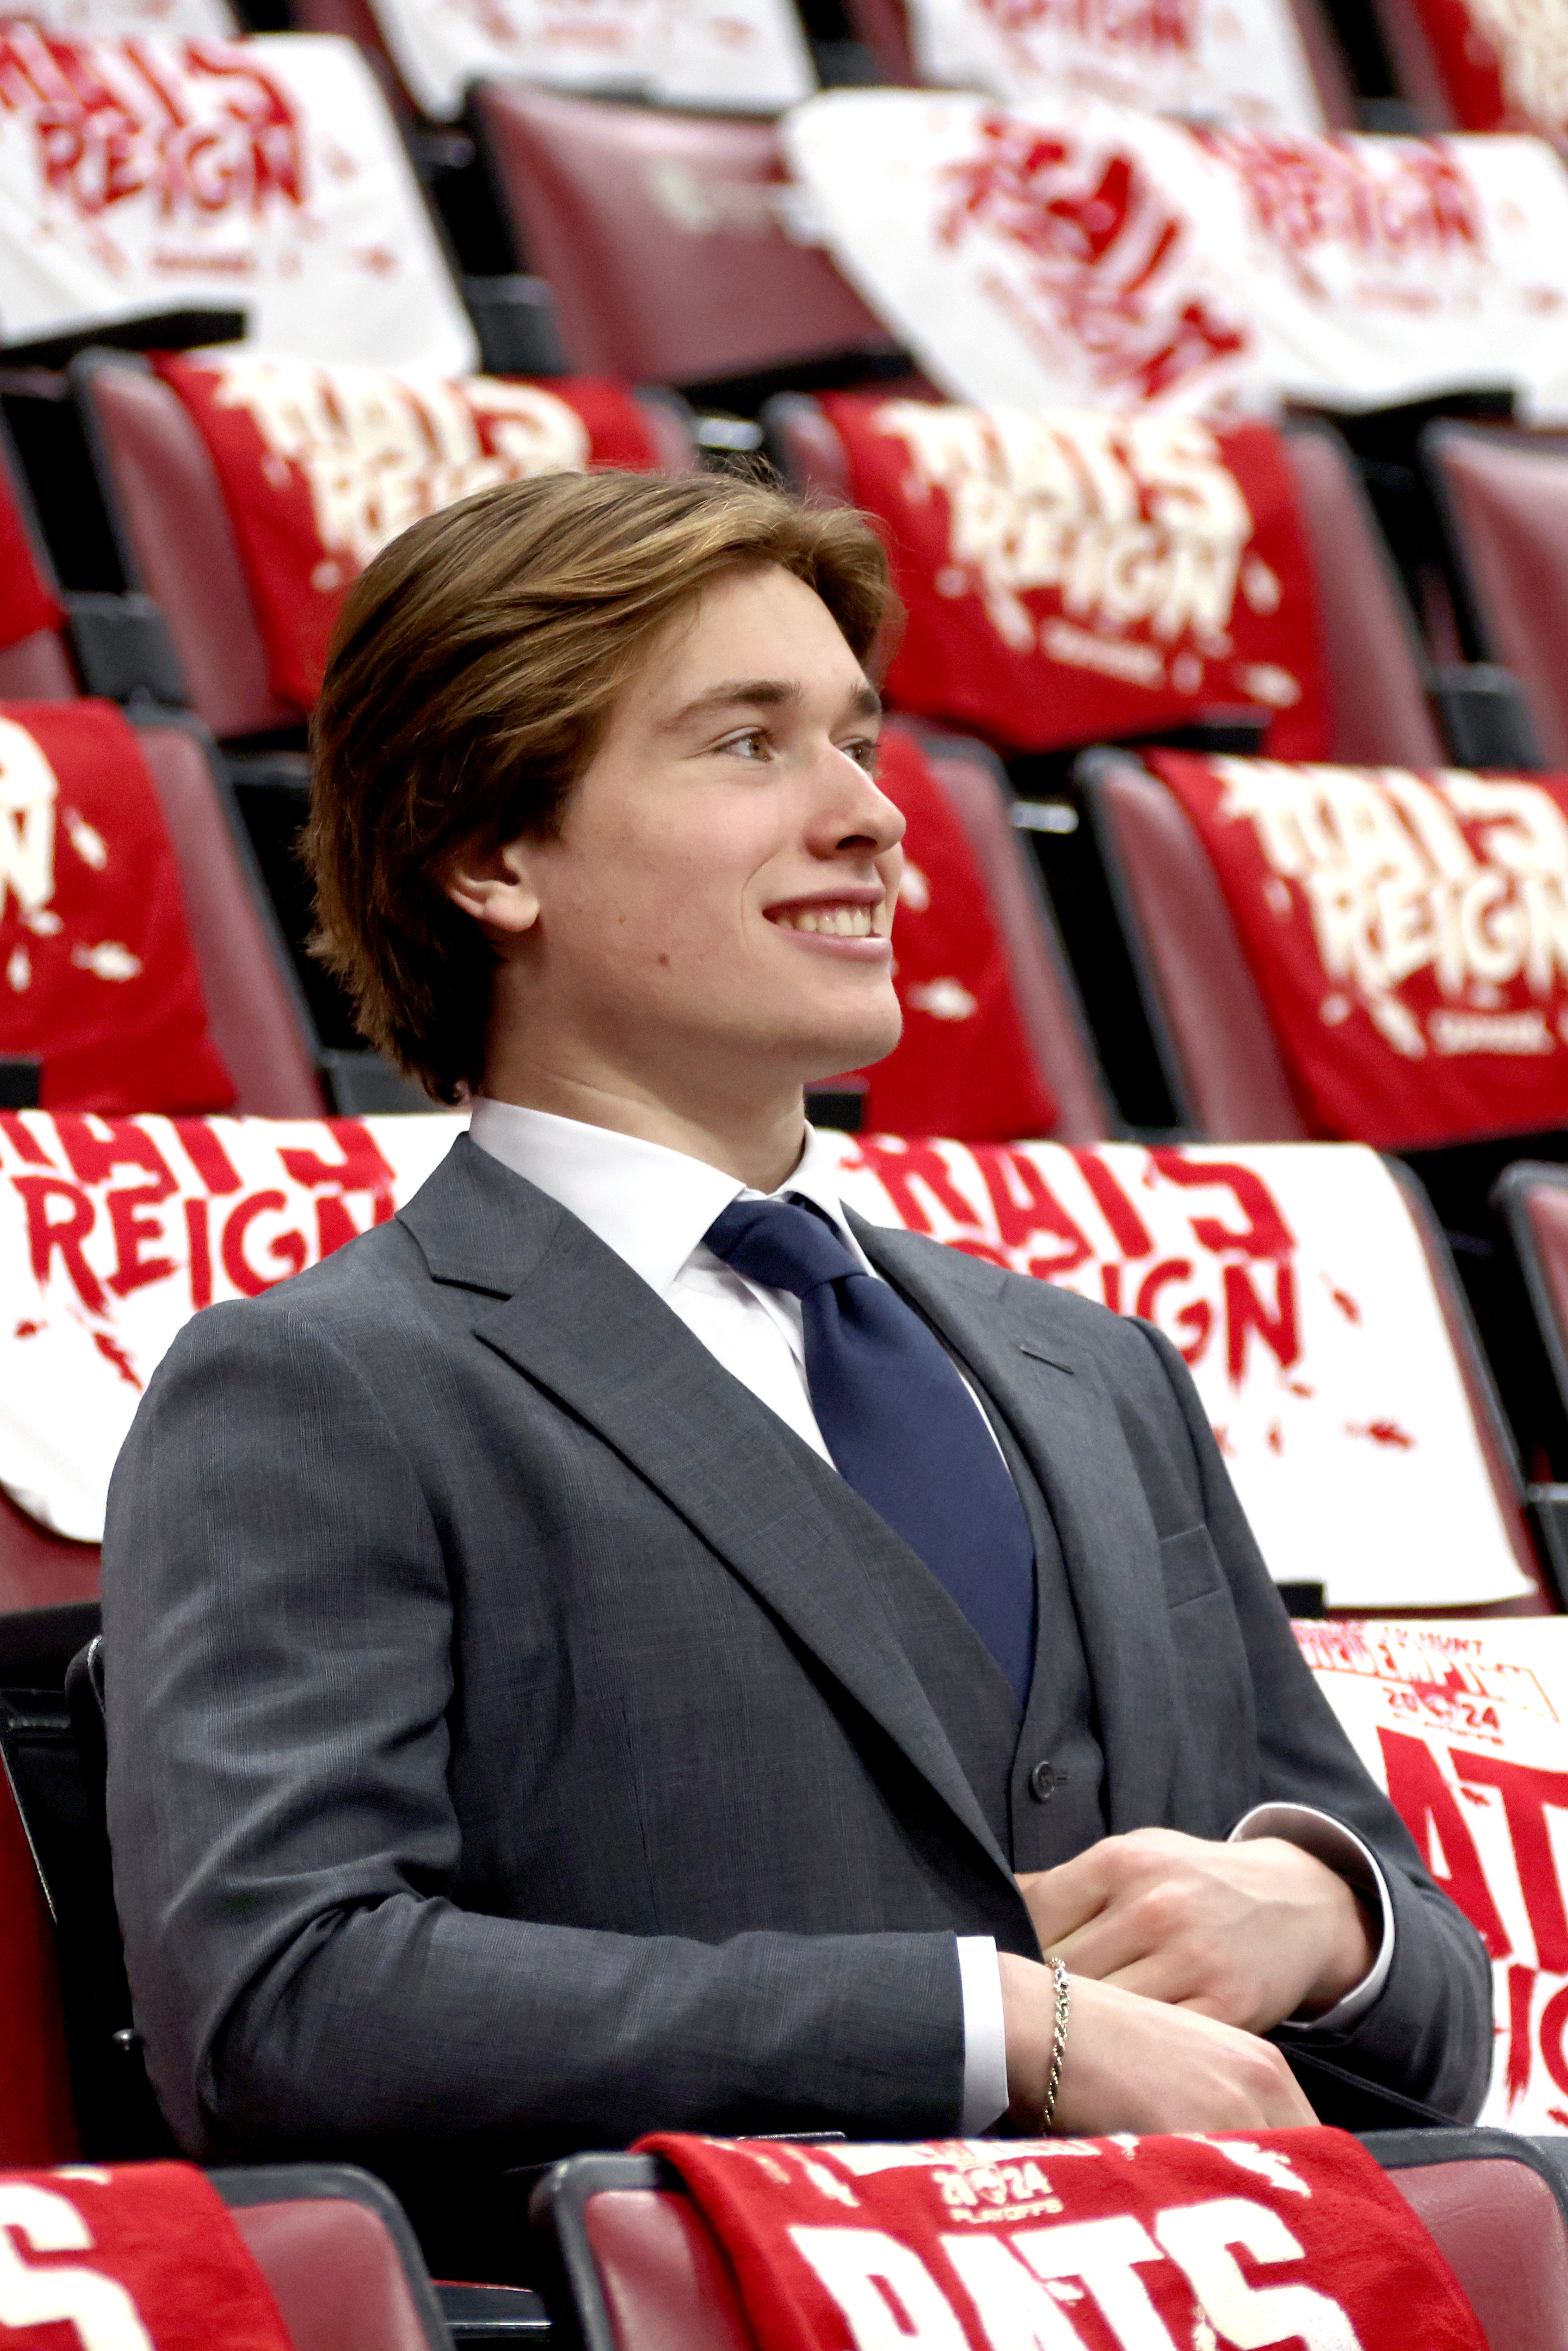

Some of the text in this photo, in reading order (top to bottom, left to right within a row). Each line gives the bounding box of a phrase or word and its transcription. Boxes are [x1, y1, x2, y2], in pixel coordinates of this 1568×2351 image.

[949, 475, 1245, 638] REIGN
[1382, 1686, 1419, 1713] 20
[1461, 1703, 1500, 1732] 24
[1001, 2161, 1054, 2200] 24
[949, 2197, 1065, 2225] PLAYOFFS
